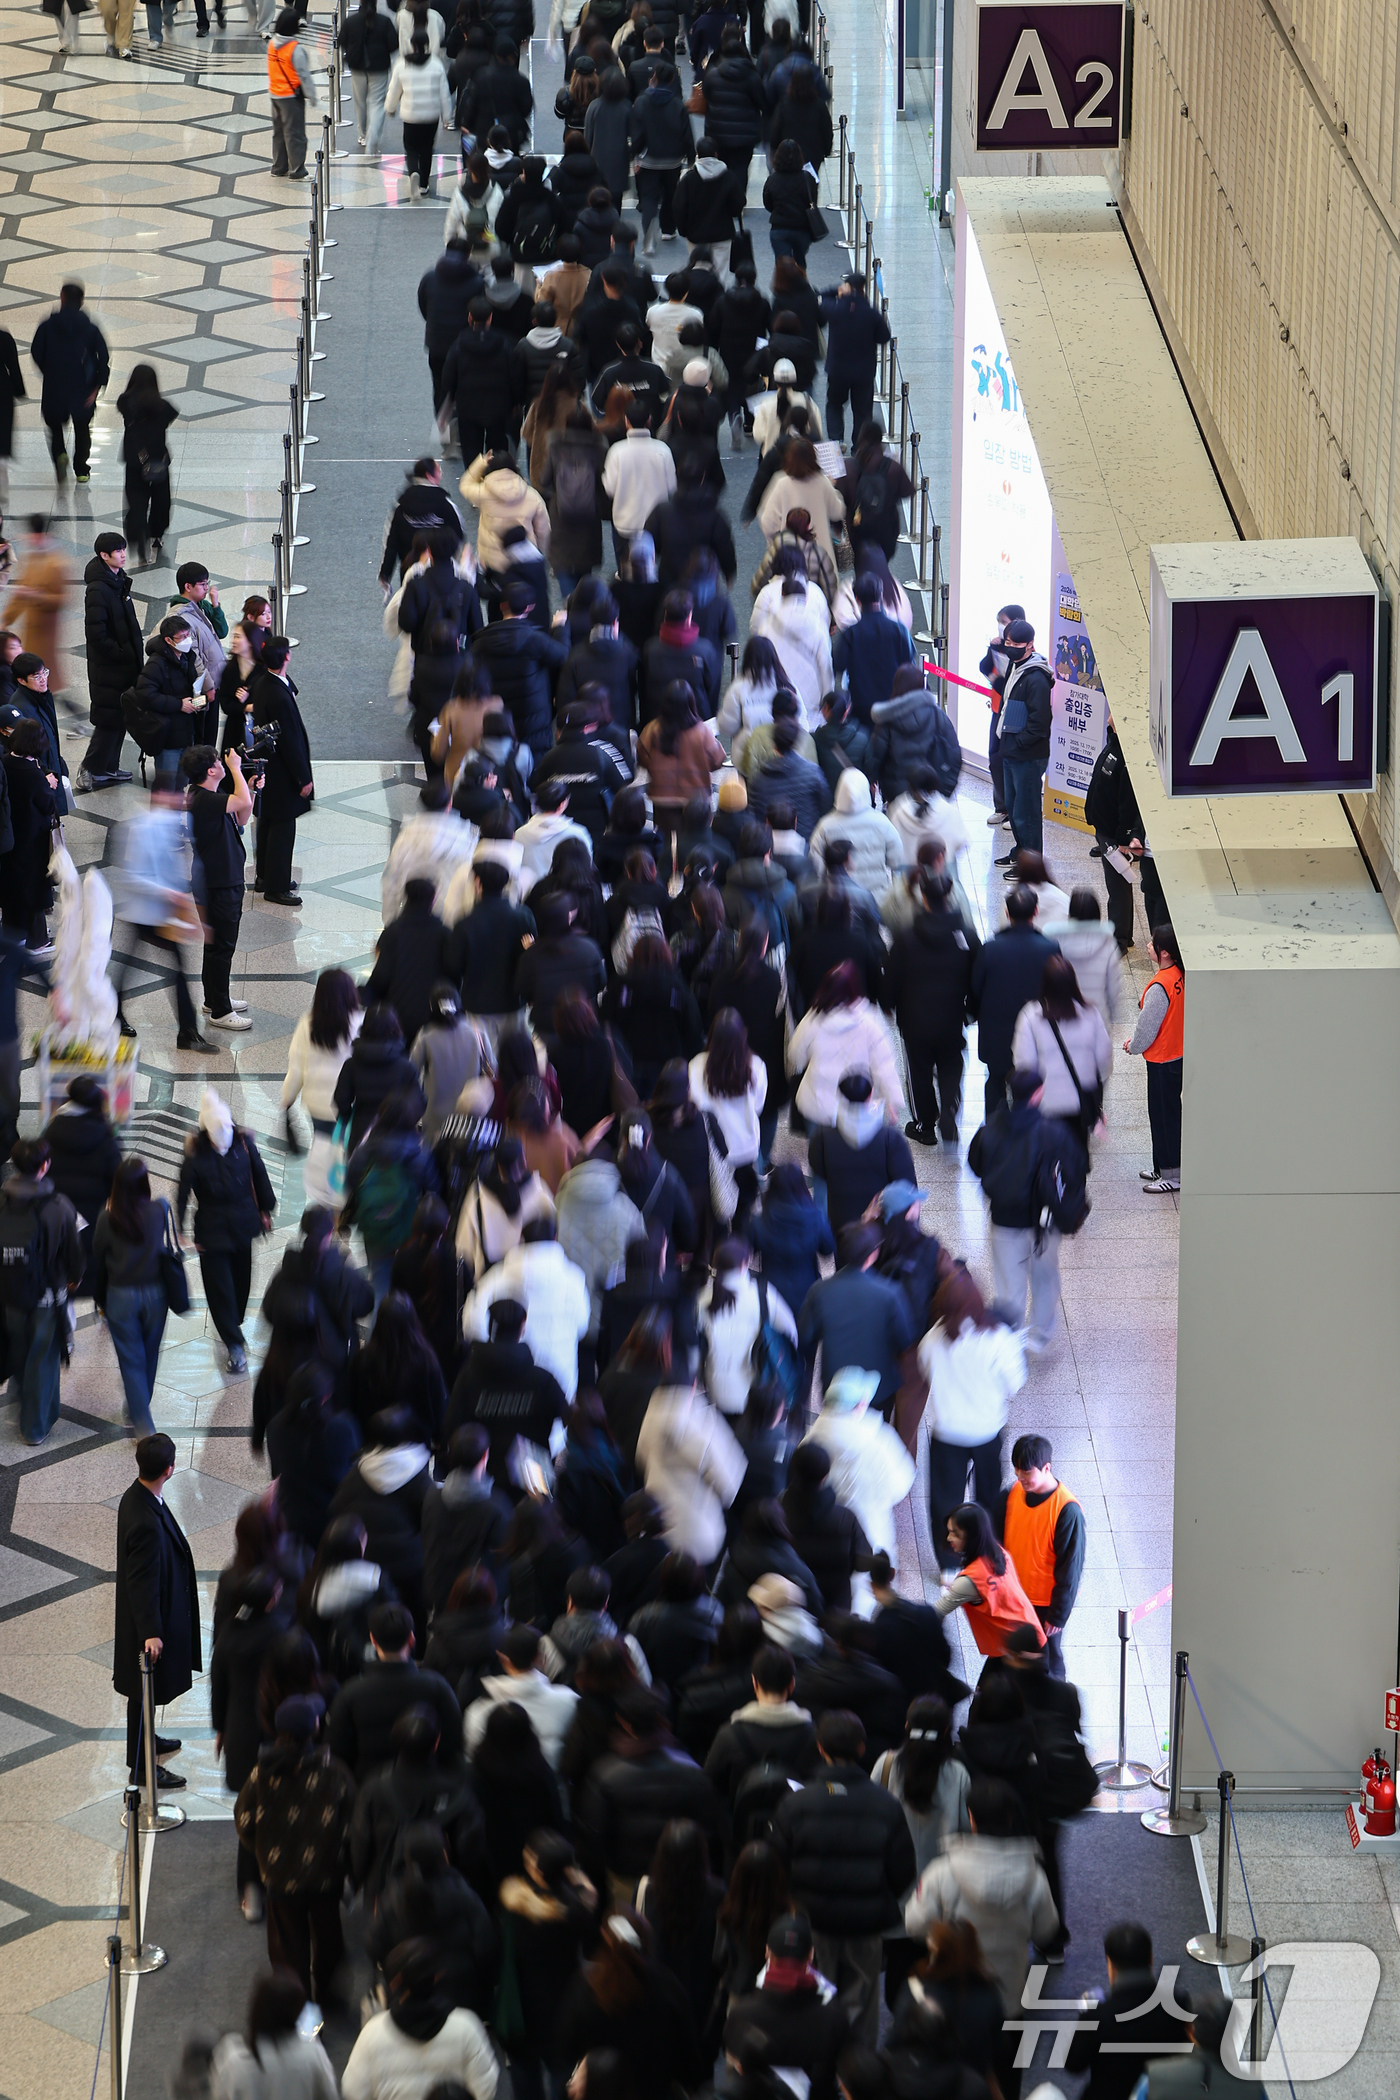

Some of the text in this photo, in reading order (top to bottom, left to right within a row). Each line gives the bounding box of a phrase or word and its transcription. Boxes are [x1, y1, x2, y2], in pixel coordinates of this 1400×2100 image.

[986, 29, 1114, 129] A2
[983, 438, 1032, 475] 입장 방법
[1070, 689, 1089, 701] 참가대학
[1189, 627, 1354, 765] A1
[1064, 697, 1093, 718] 출입증
[1068, 716, 1087, 733] 배부
[1057, 736, 1066, 747] 1차
[1055, 761, 1065, 773] 2차
